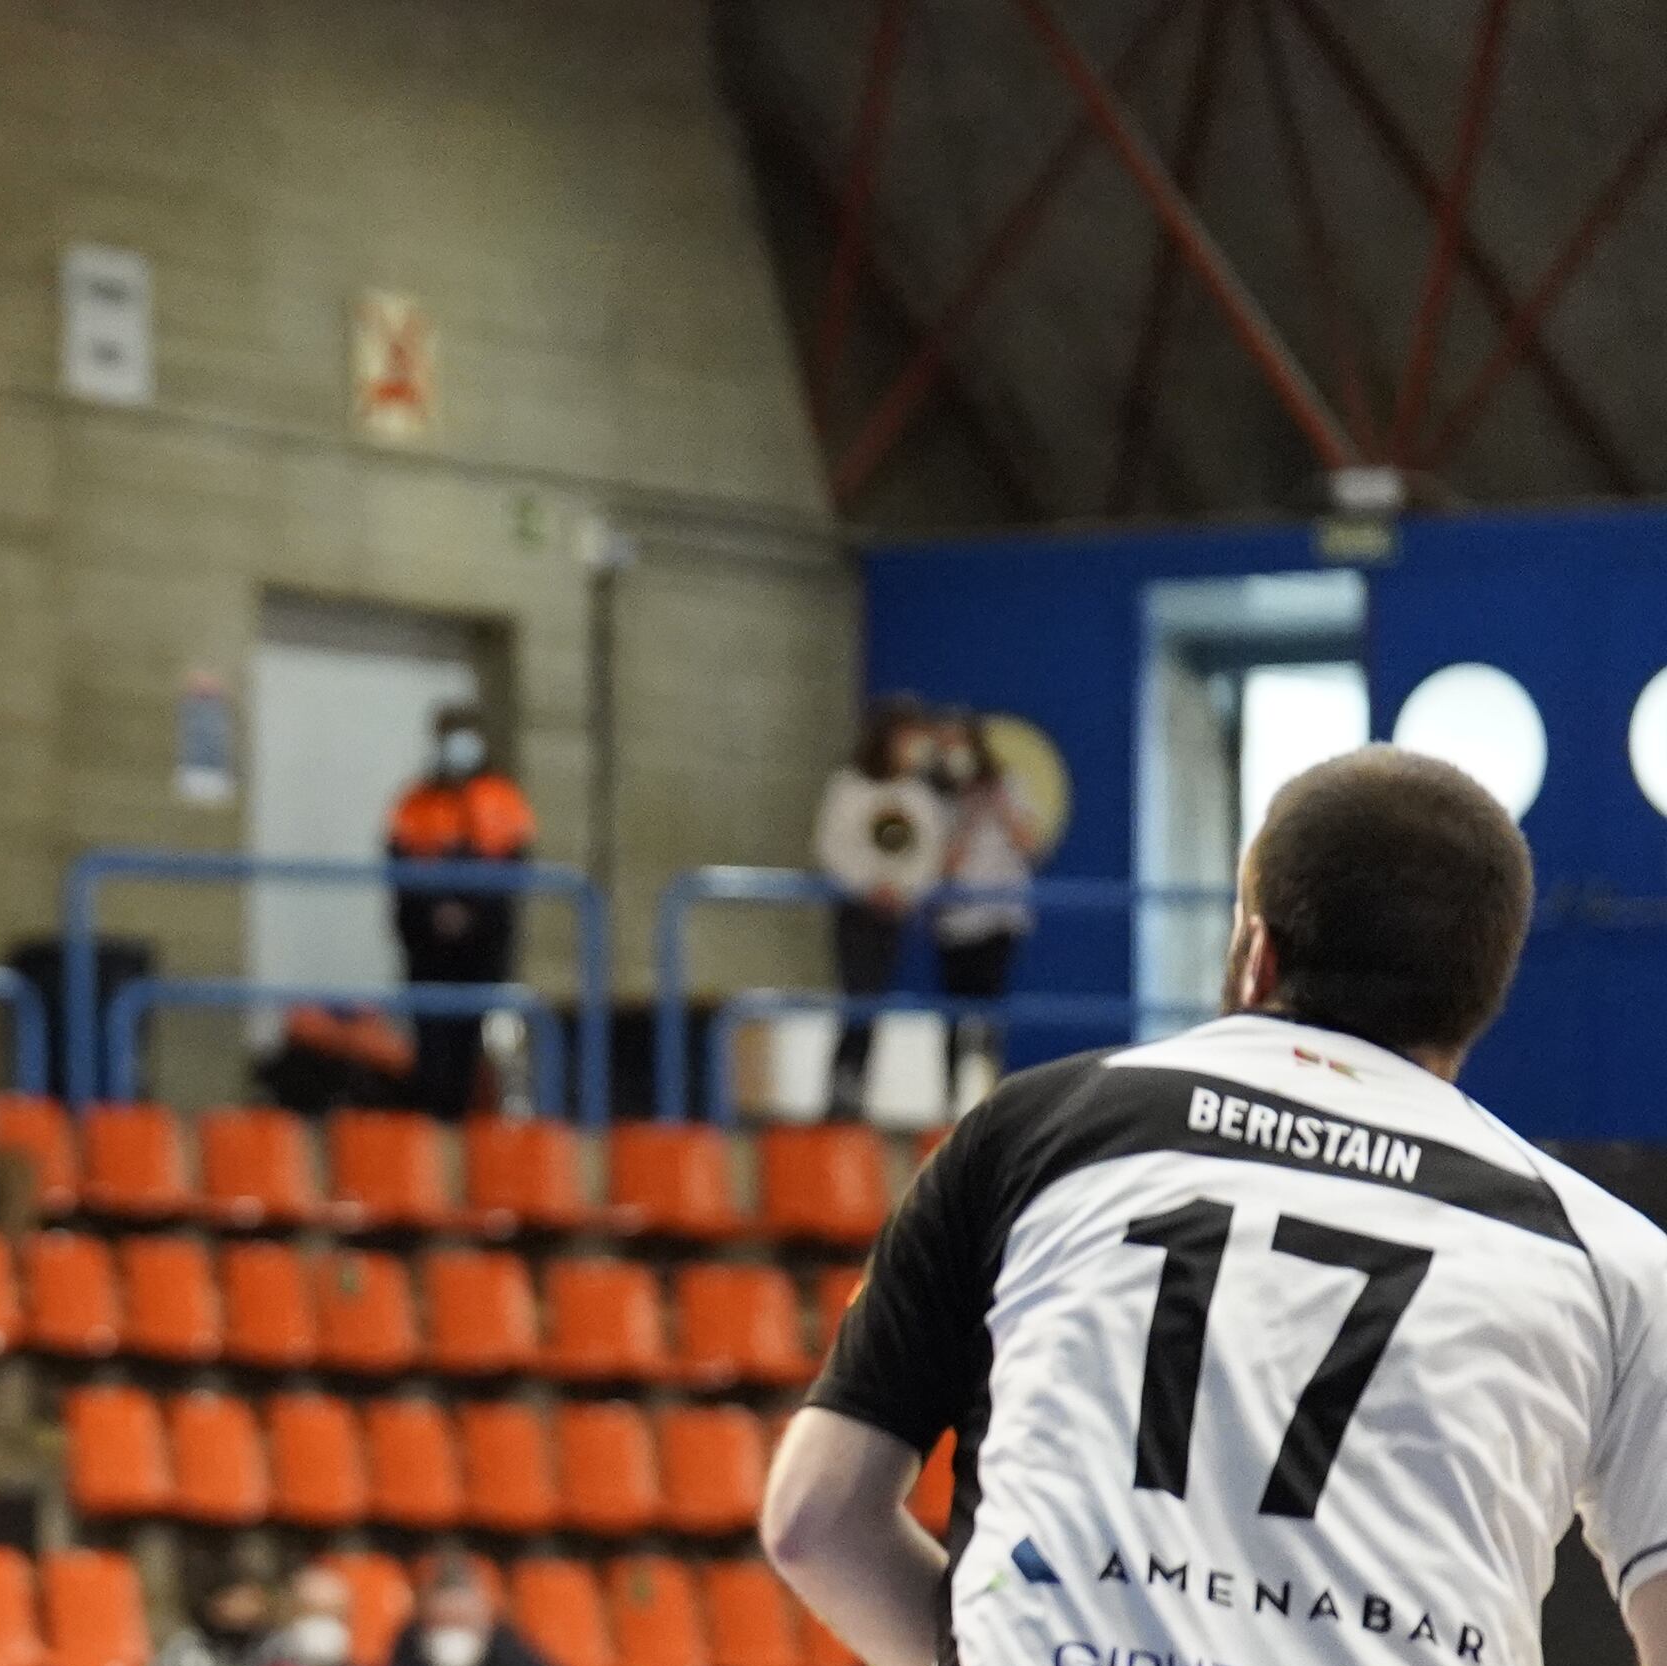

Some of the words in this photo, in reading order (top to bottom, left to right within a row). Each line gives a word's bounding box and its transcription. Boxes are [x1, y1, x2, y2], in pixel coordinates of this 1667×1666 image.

[1187, 1086, 1423, 1184] BERISTAIN
[1122, 1196, 1434, 1520] 17
[1099, 1550, 1485, 1664] AMENABAR
